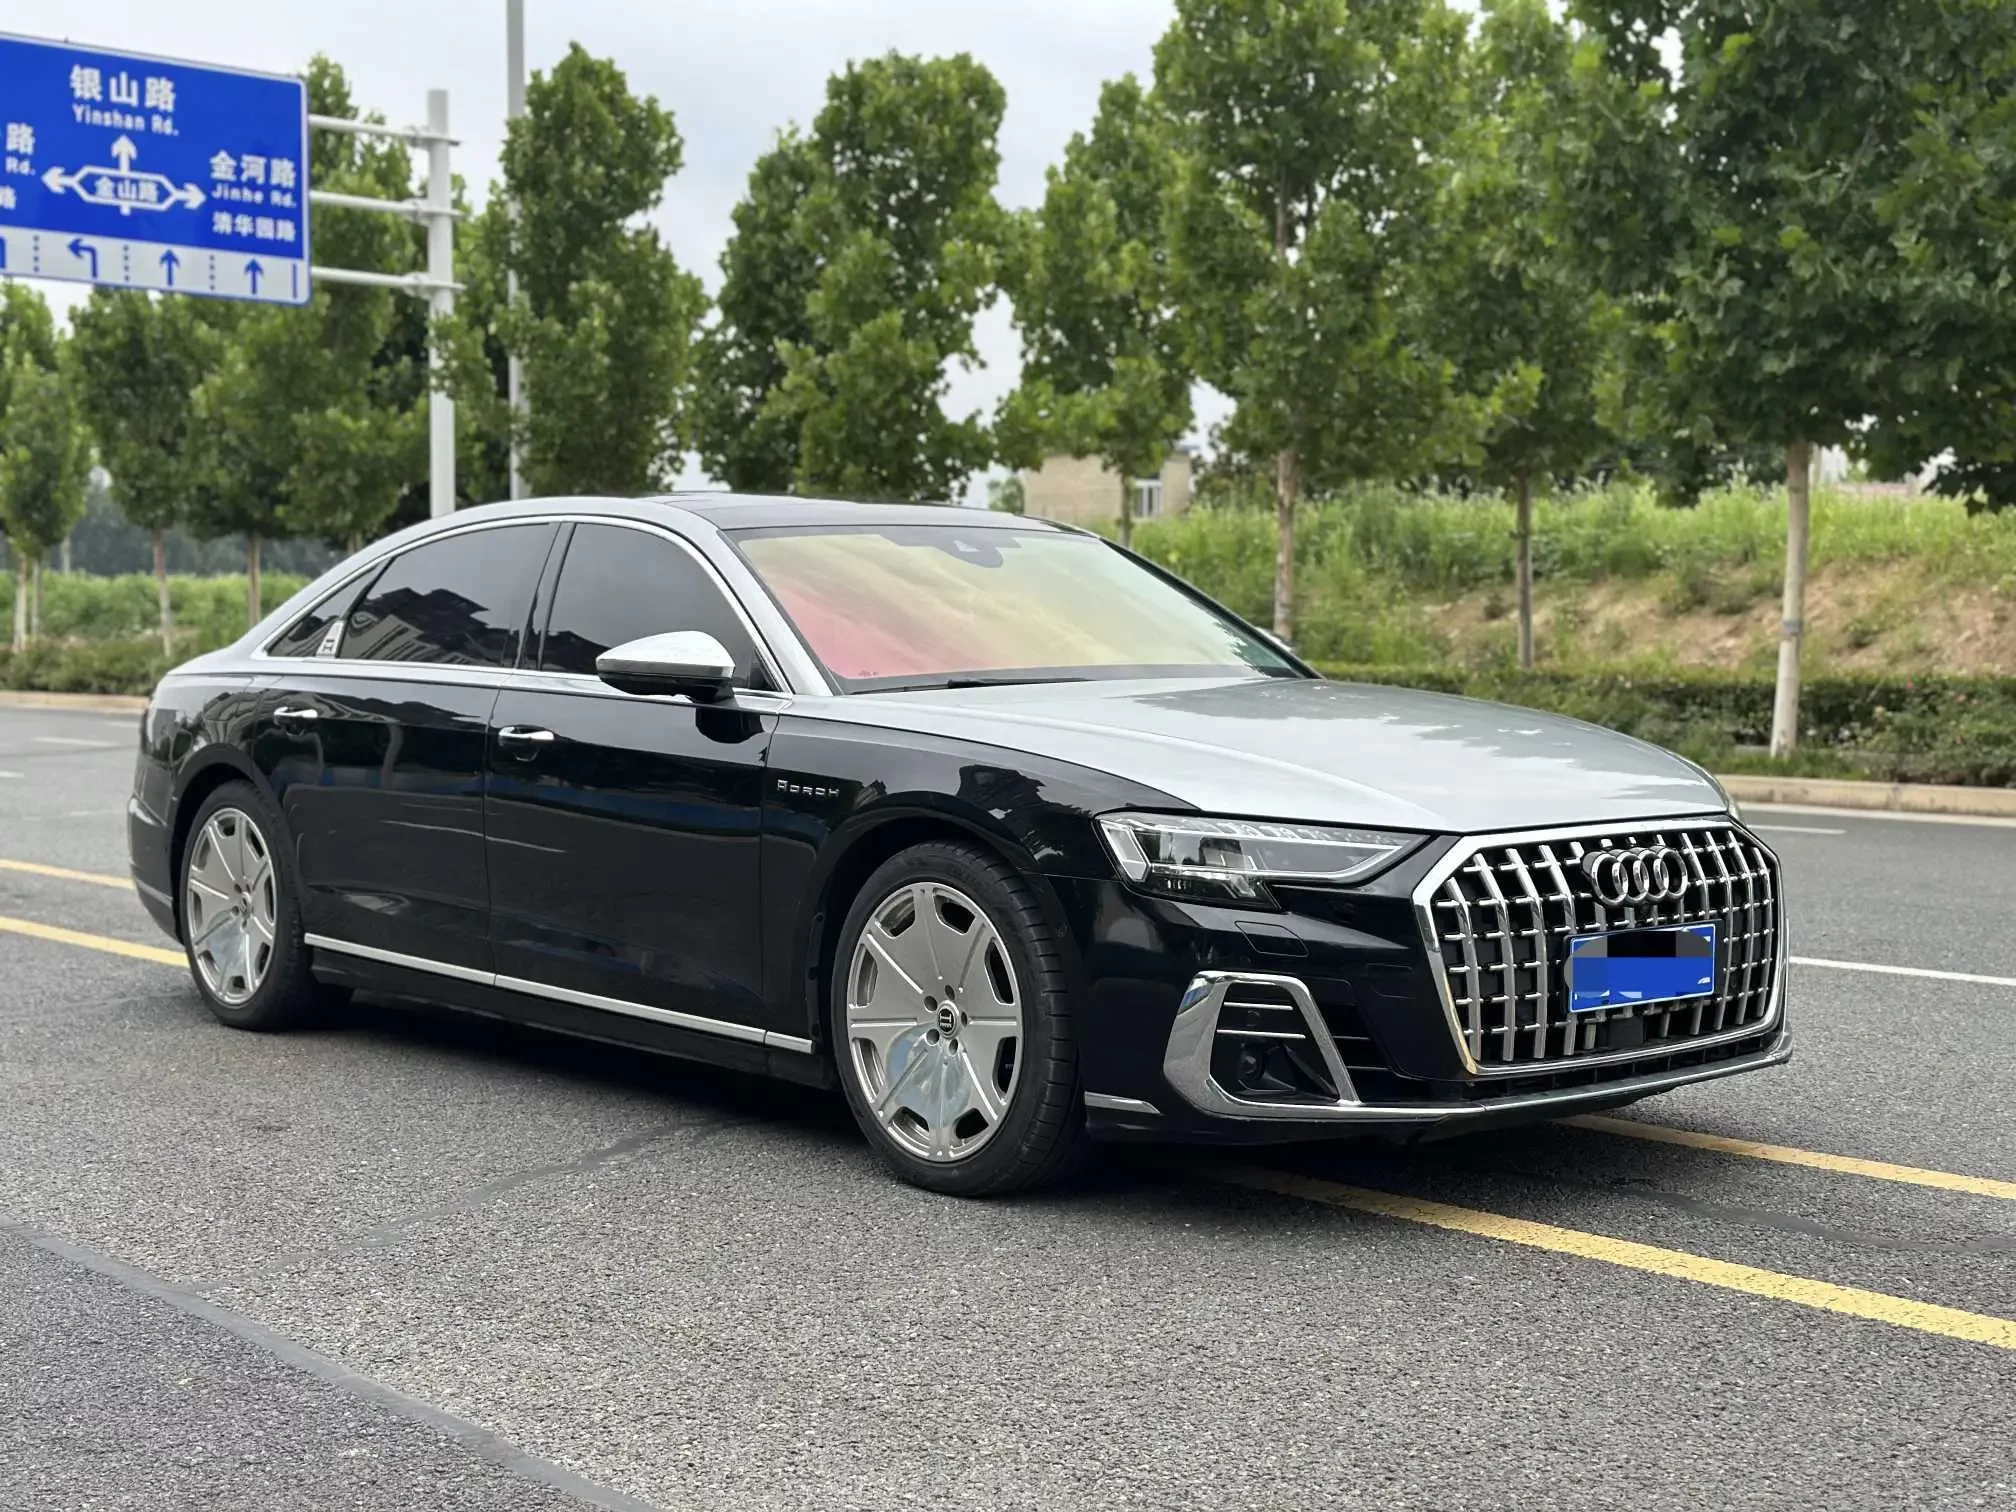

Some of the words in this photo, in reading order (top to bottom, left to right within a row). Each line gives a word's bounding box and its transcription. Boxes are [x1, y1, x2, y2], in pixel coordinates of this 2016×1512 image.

[70, 64, 175, 112] 银山路
[72, 102, 145, 132] Yinshan
[151, 113, 179, 136] Rd.
[5, 155, 36, 176] Rd.
[209, 149, 296, 189] 金河路
[94, 175, 158, 202] 金山路
[211, 182, 264, 204] Jinhe
[269, 189, 297, 208] Rd.
